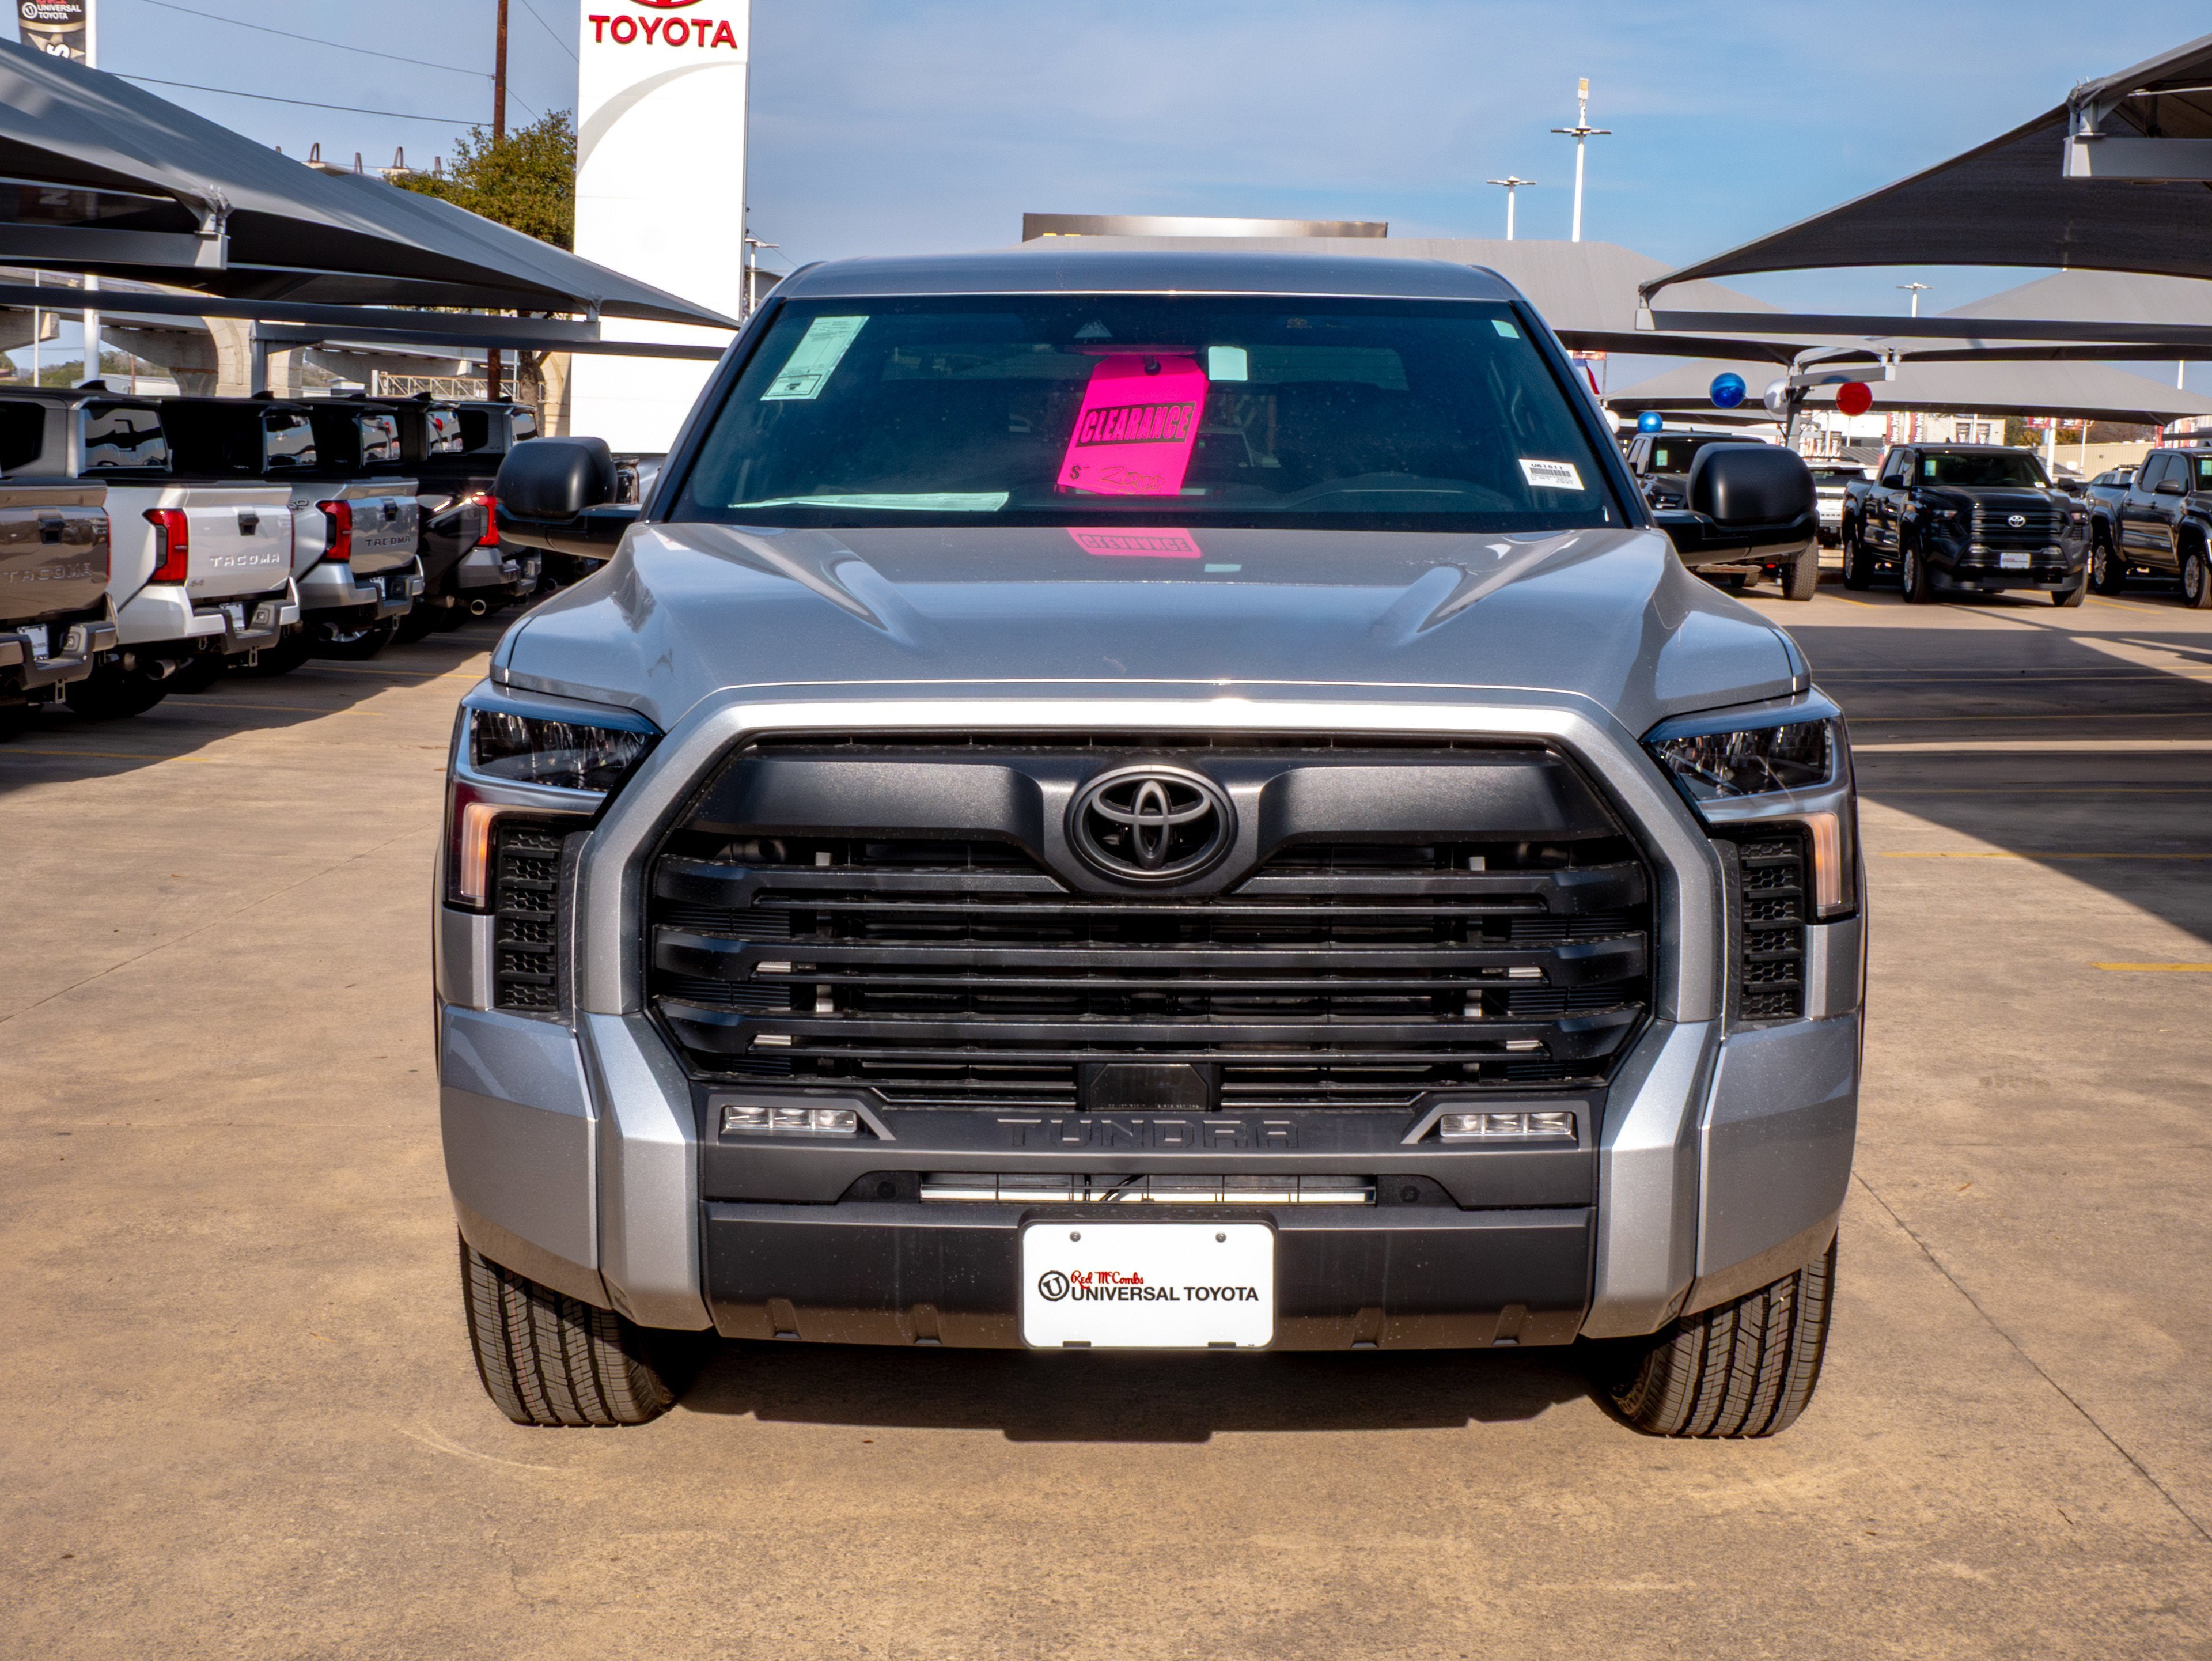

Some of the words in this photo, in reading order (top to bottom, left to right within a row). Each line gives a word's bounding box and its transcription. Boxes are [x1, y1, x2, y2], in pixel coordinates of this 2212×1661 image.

[37, 4, 82, 12] UNIVERSAL
[37, 12, 68, 20] TOYOTA
[589, 14, 737, 49] TOYOTA
[1080, 405, 1192, 444] CLEARANCE
[1070, 465, 1081, 480] $
[365, 536, 411, 548] TACOMA
[209, 553, 281, 568] TACOMA
[3, 562, 93, 583] TACOMA
[997, 1118, 1299, 1149] TUNDRA
[1071, 1270, 1093, 1289] Red
[1071, 1286, 1180, 1301] UNIVERSAL
[1183, 1286, 1259, 1301] TOYOTA
